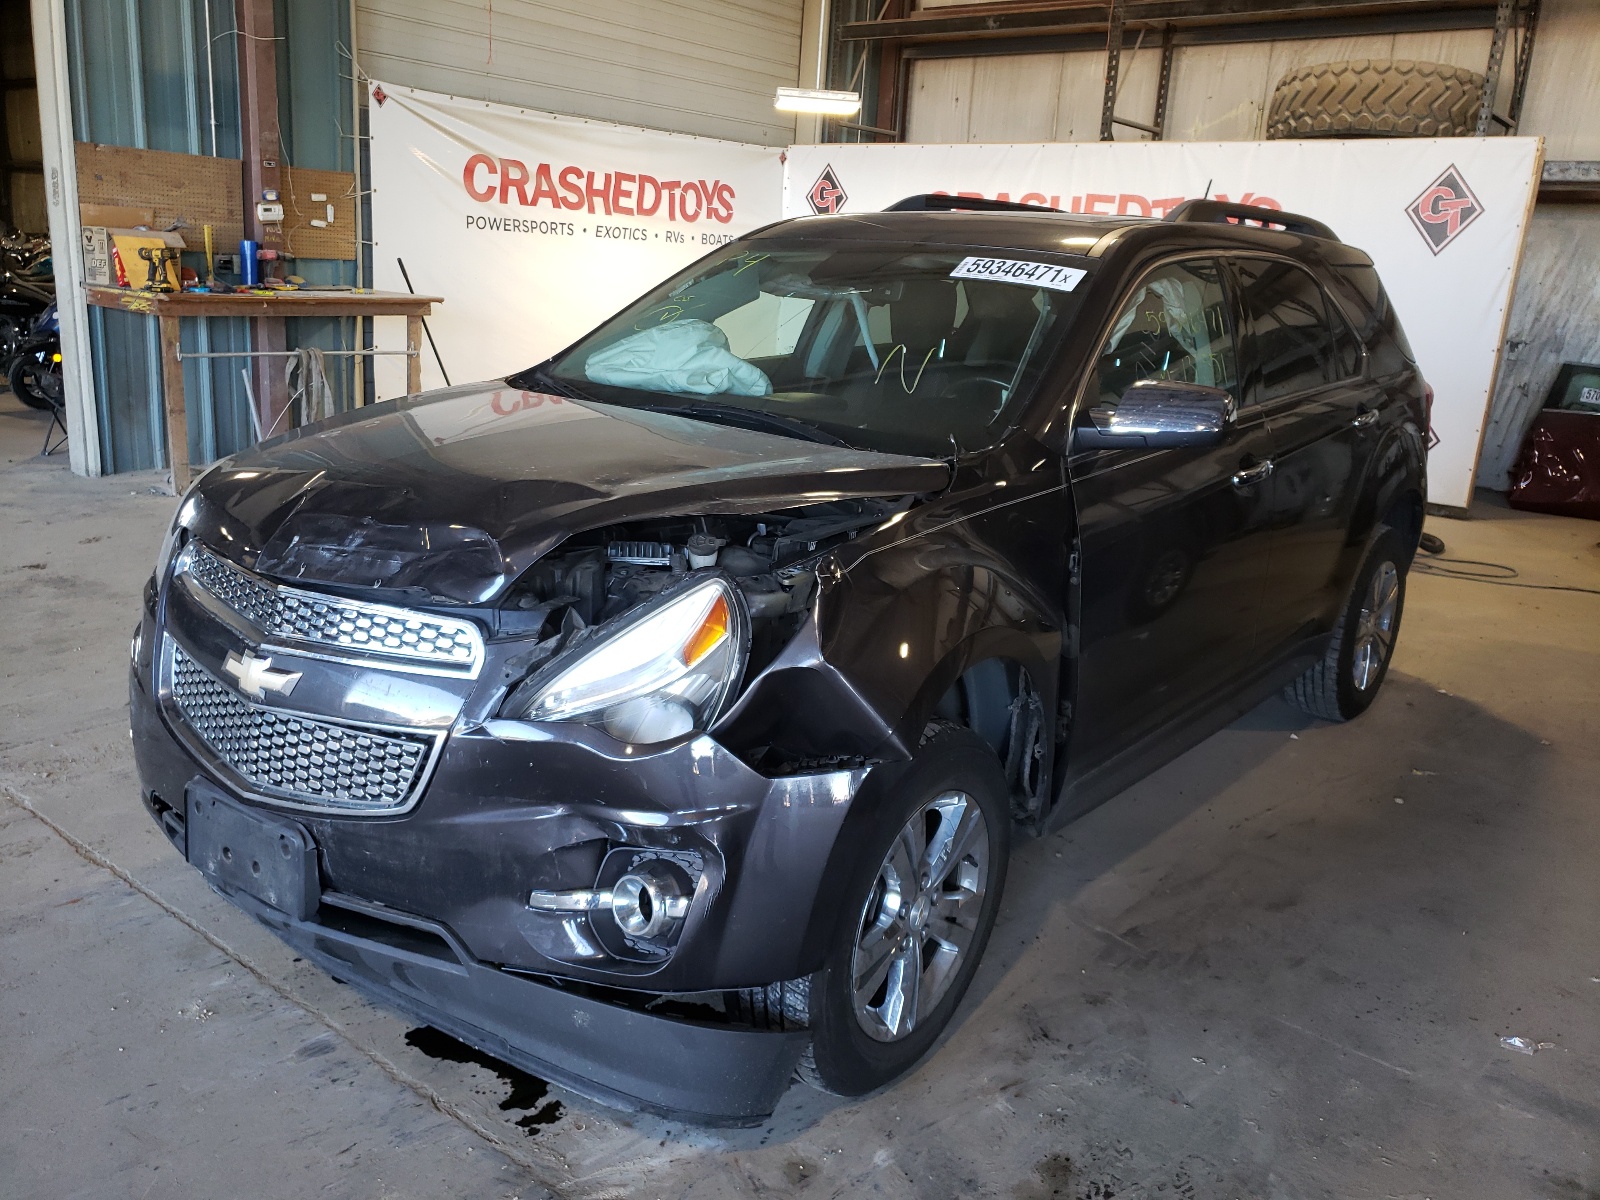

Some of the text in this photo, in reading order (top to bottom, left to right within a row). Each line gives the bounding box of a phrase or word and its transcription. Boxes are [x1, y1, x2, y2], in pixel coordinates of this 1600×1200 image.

[463, 153, 735, 224] CRASHEDTOYS
[466, 215, 574, 236] POWERSPORTS
[595, 225, 647, 241] EXOTICS
[665, 230, 685, 244] RVs
